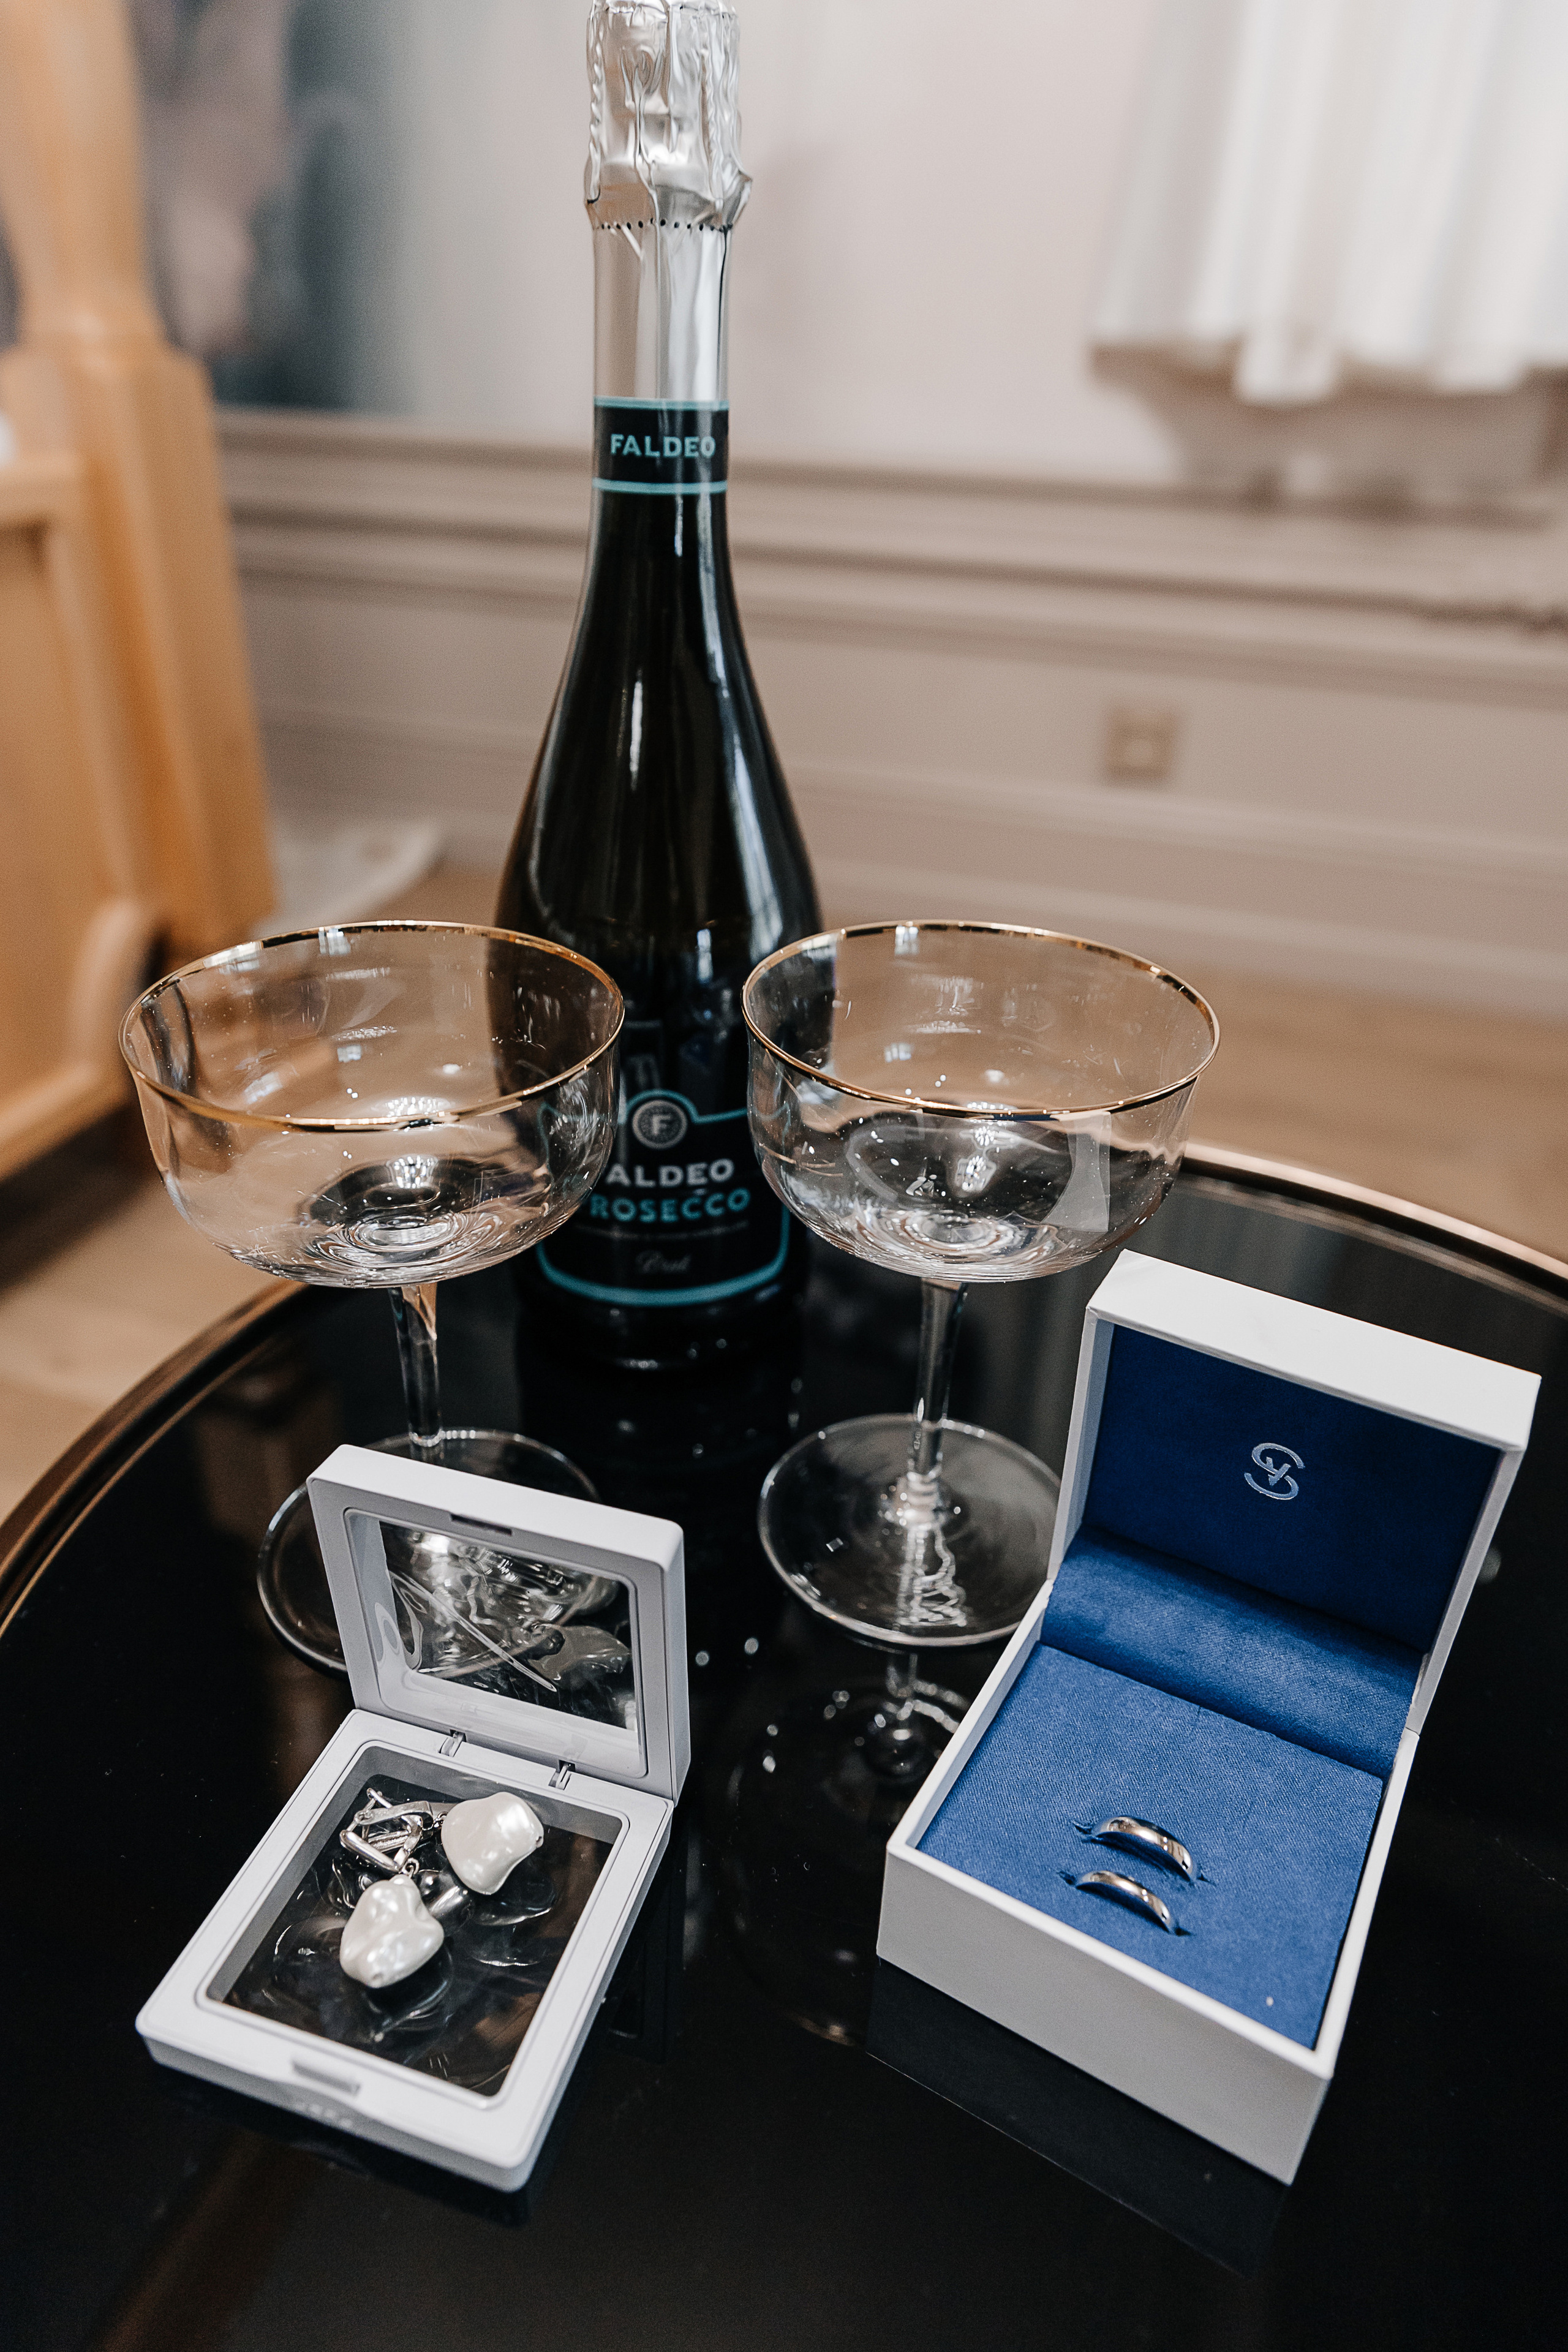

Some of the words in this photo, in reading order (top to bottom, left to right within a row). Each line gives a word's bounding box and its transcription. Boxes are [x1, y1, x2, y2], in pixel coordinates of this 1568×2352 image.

[611, 434, 715, 457] FALDEO
[651, 1114, 672, 1136] F
[605, 1158, 734, 1188] ALDEO
[587, 1188, 751, 1223] ROSECCO
